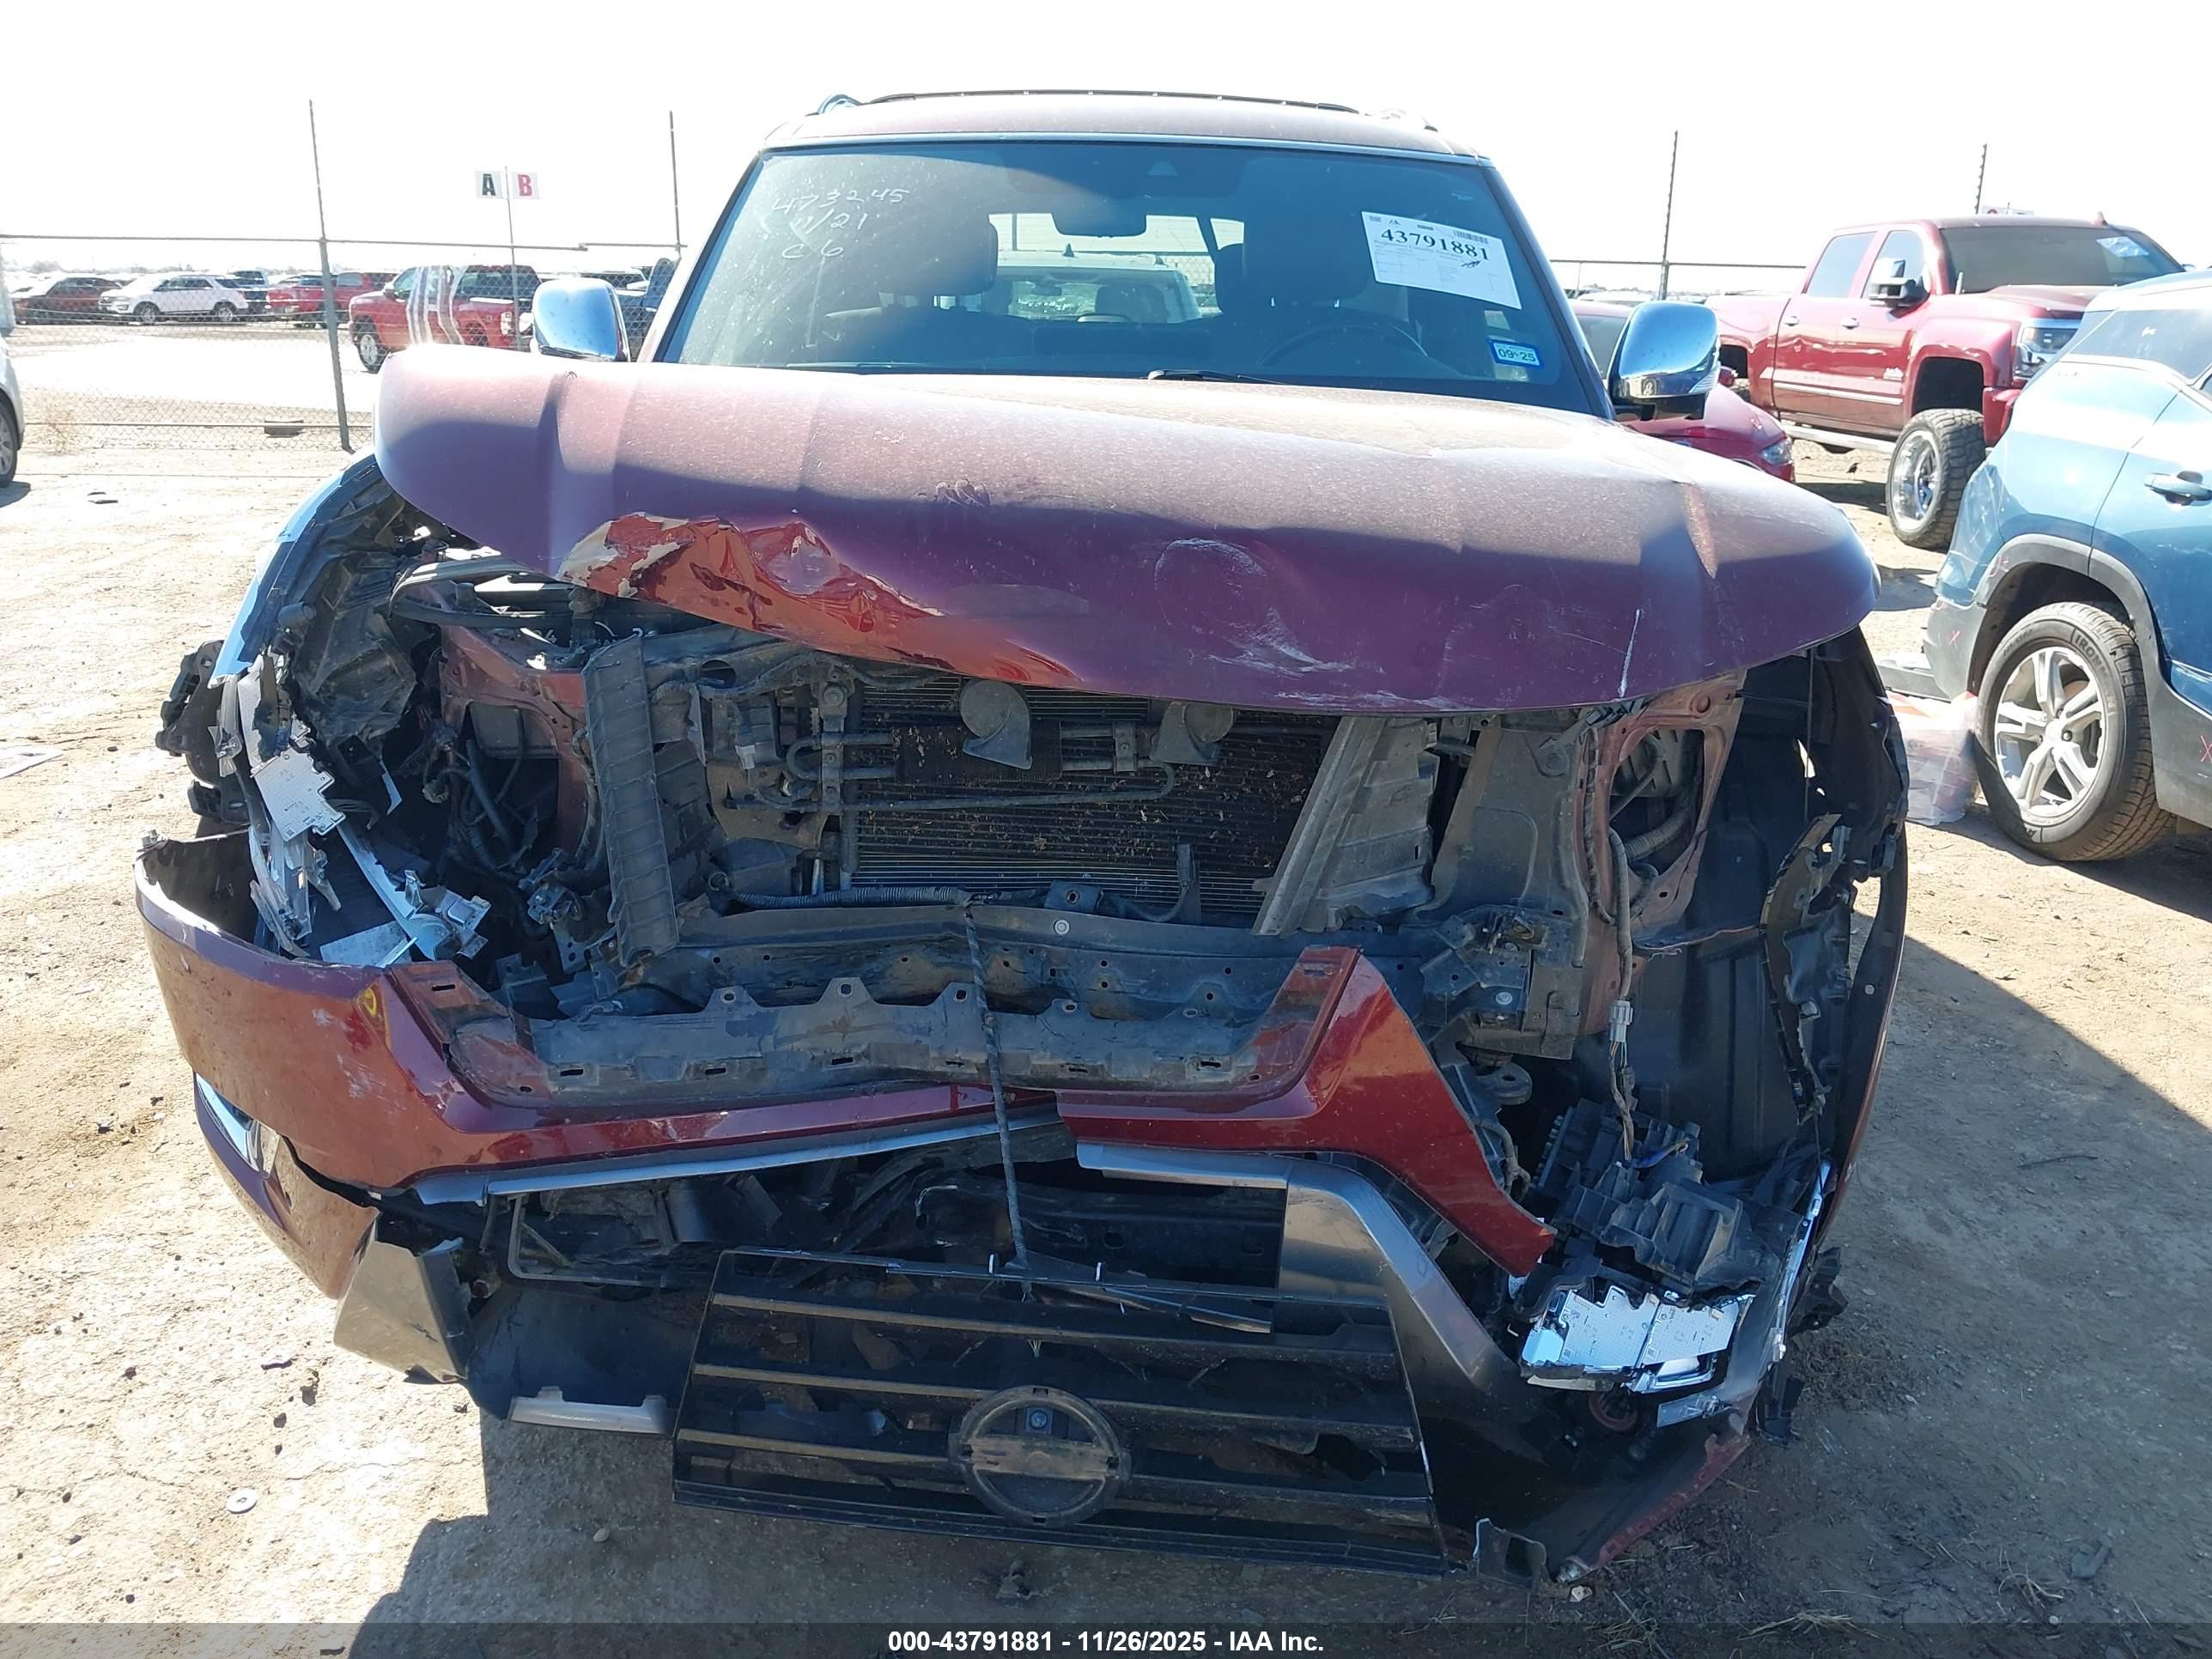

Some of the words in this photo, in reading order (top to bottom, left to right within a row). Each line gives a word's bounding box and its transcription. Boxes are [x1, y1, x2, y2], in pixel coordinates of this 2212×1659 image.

[482, 173, 496, 197] A
[517, 173, 532, 197] B
[1381, 228, 1489, 260] 43791881
